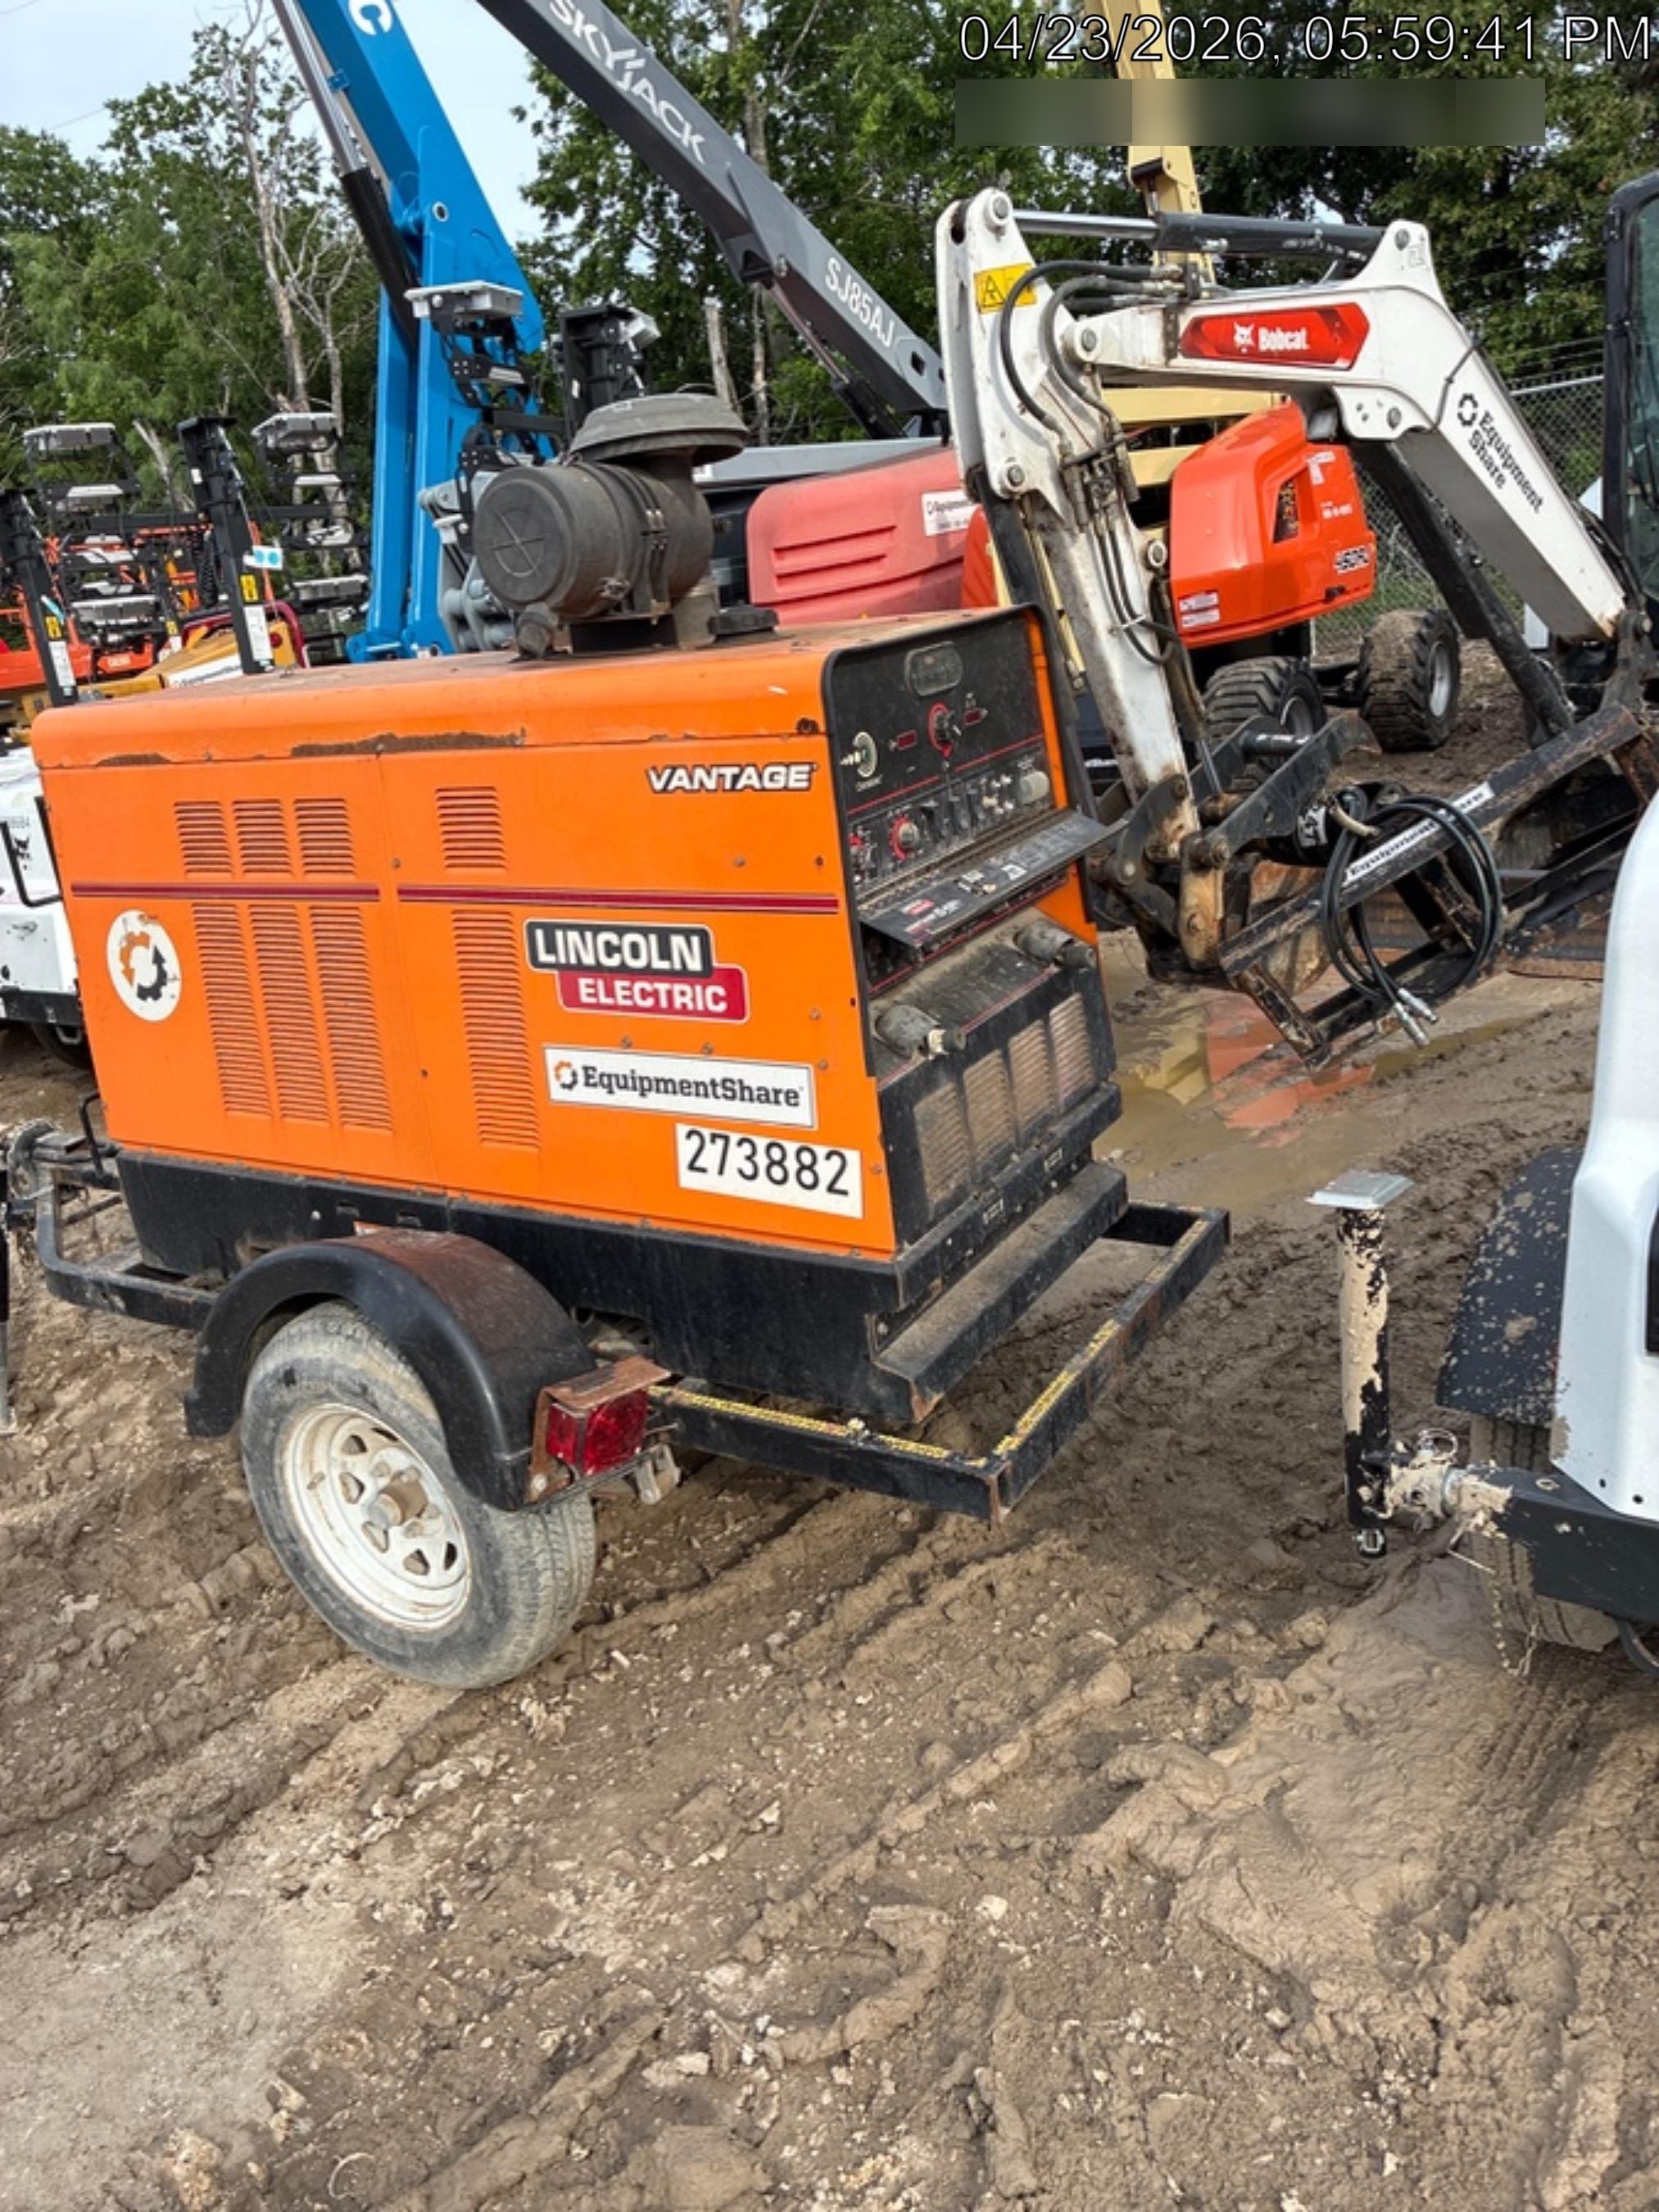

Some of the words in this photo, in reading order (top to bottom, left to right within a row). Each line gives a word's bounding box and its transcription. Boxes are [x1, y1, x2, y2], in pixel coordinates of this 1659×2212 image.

[825, 256, 895, 348] SJ85AJ
[1258, 326, 1311, 352] Bobcat
[1469, 428, 1506, 489] Share
[1479, 410, 1543, 514] Equipment
[646, 762, 814, 794] VANTAGE
[534, 928, 704, 972] LINCOLN
[577, 977, 728, 1013] ELECTRIC
[582, 1066, 802, 1108] EquipmentShare
[684, 1129, 850, 1197] 273882
